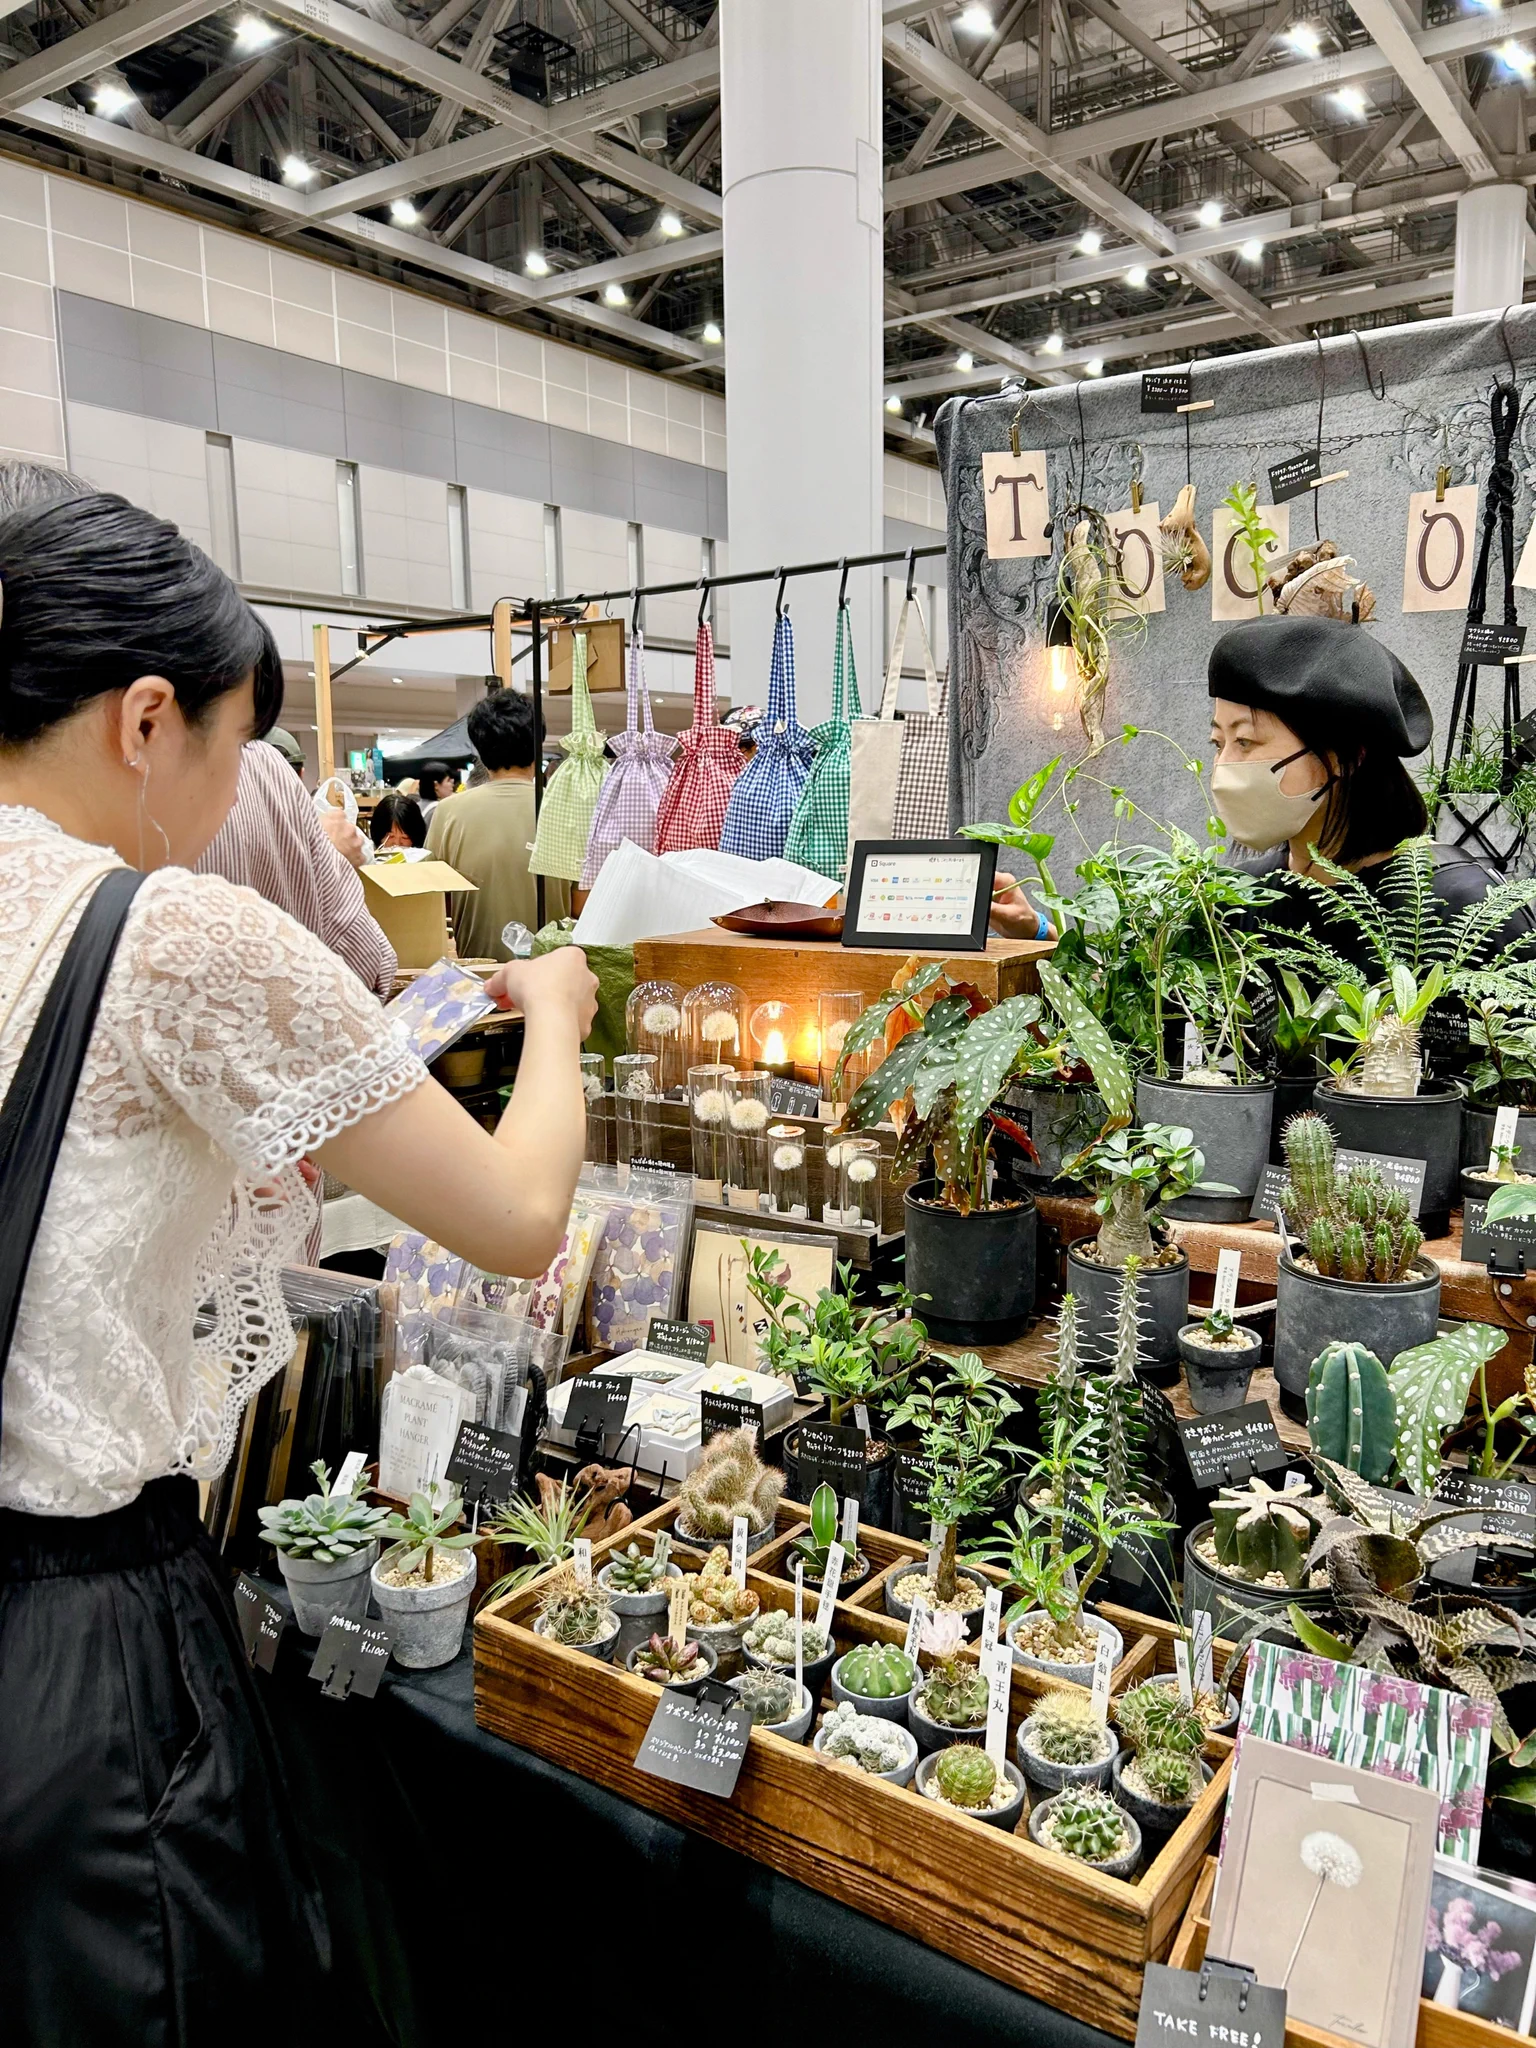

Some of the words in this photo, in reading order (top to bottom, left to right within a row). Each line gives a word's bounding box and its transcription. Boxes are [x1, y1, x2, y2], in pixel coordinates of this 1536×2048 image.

[989, 473, 1044, 541] T
[1417, 509, 1464, 593] O
[400, 1394, 438, 1413] MACRAMÉ
[404, 1412, 429, 1428] PLANT
[1245, 1422, 1274, 1435] ¥4800
[400, 1427, 430, 1446] HANGER
[992, 1660, 1008, 1713] 青王丸
[1153, 2010, 1198, 2036] TAKE
[1209, 2022, 1262, 2048] FREE!
